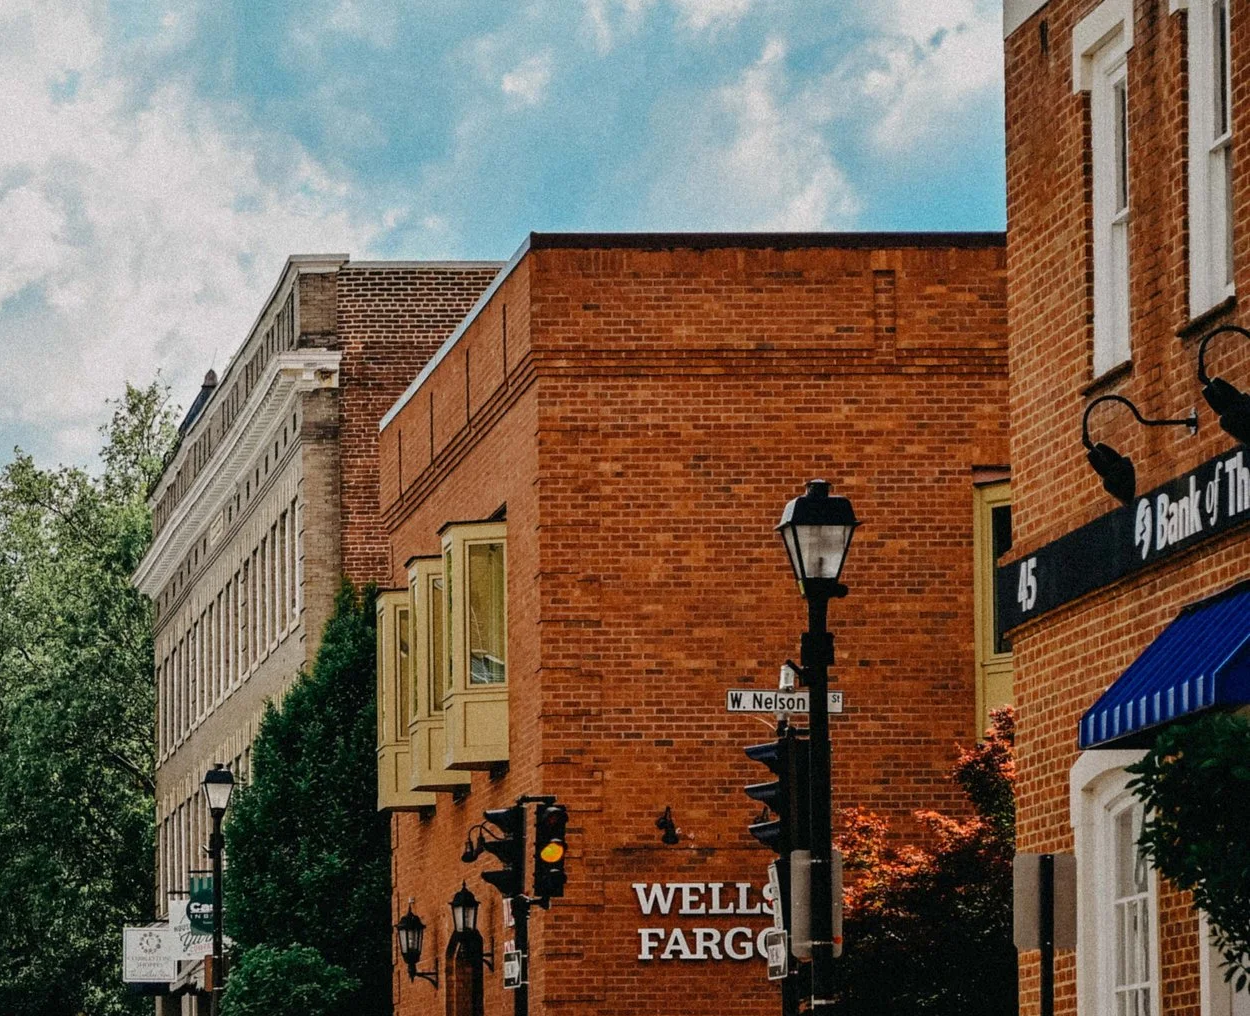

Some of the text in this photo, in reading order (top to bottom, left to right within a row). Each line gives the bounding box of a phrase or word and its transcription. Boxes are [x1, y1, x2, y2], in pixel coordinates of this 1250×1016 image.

[1156, 475, 1203, 551] Bank
[1205, 460, 1223, 527] of
[1017, 557, 1038, 612] 45
[730, 692, 841, 710] W. Nelson St
